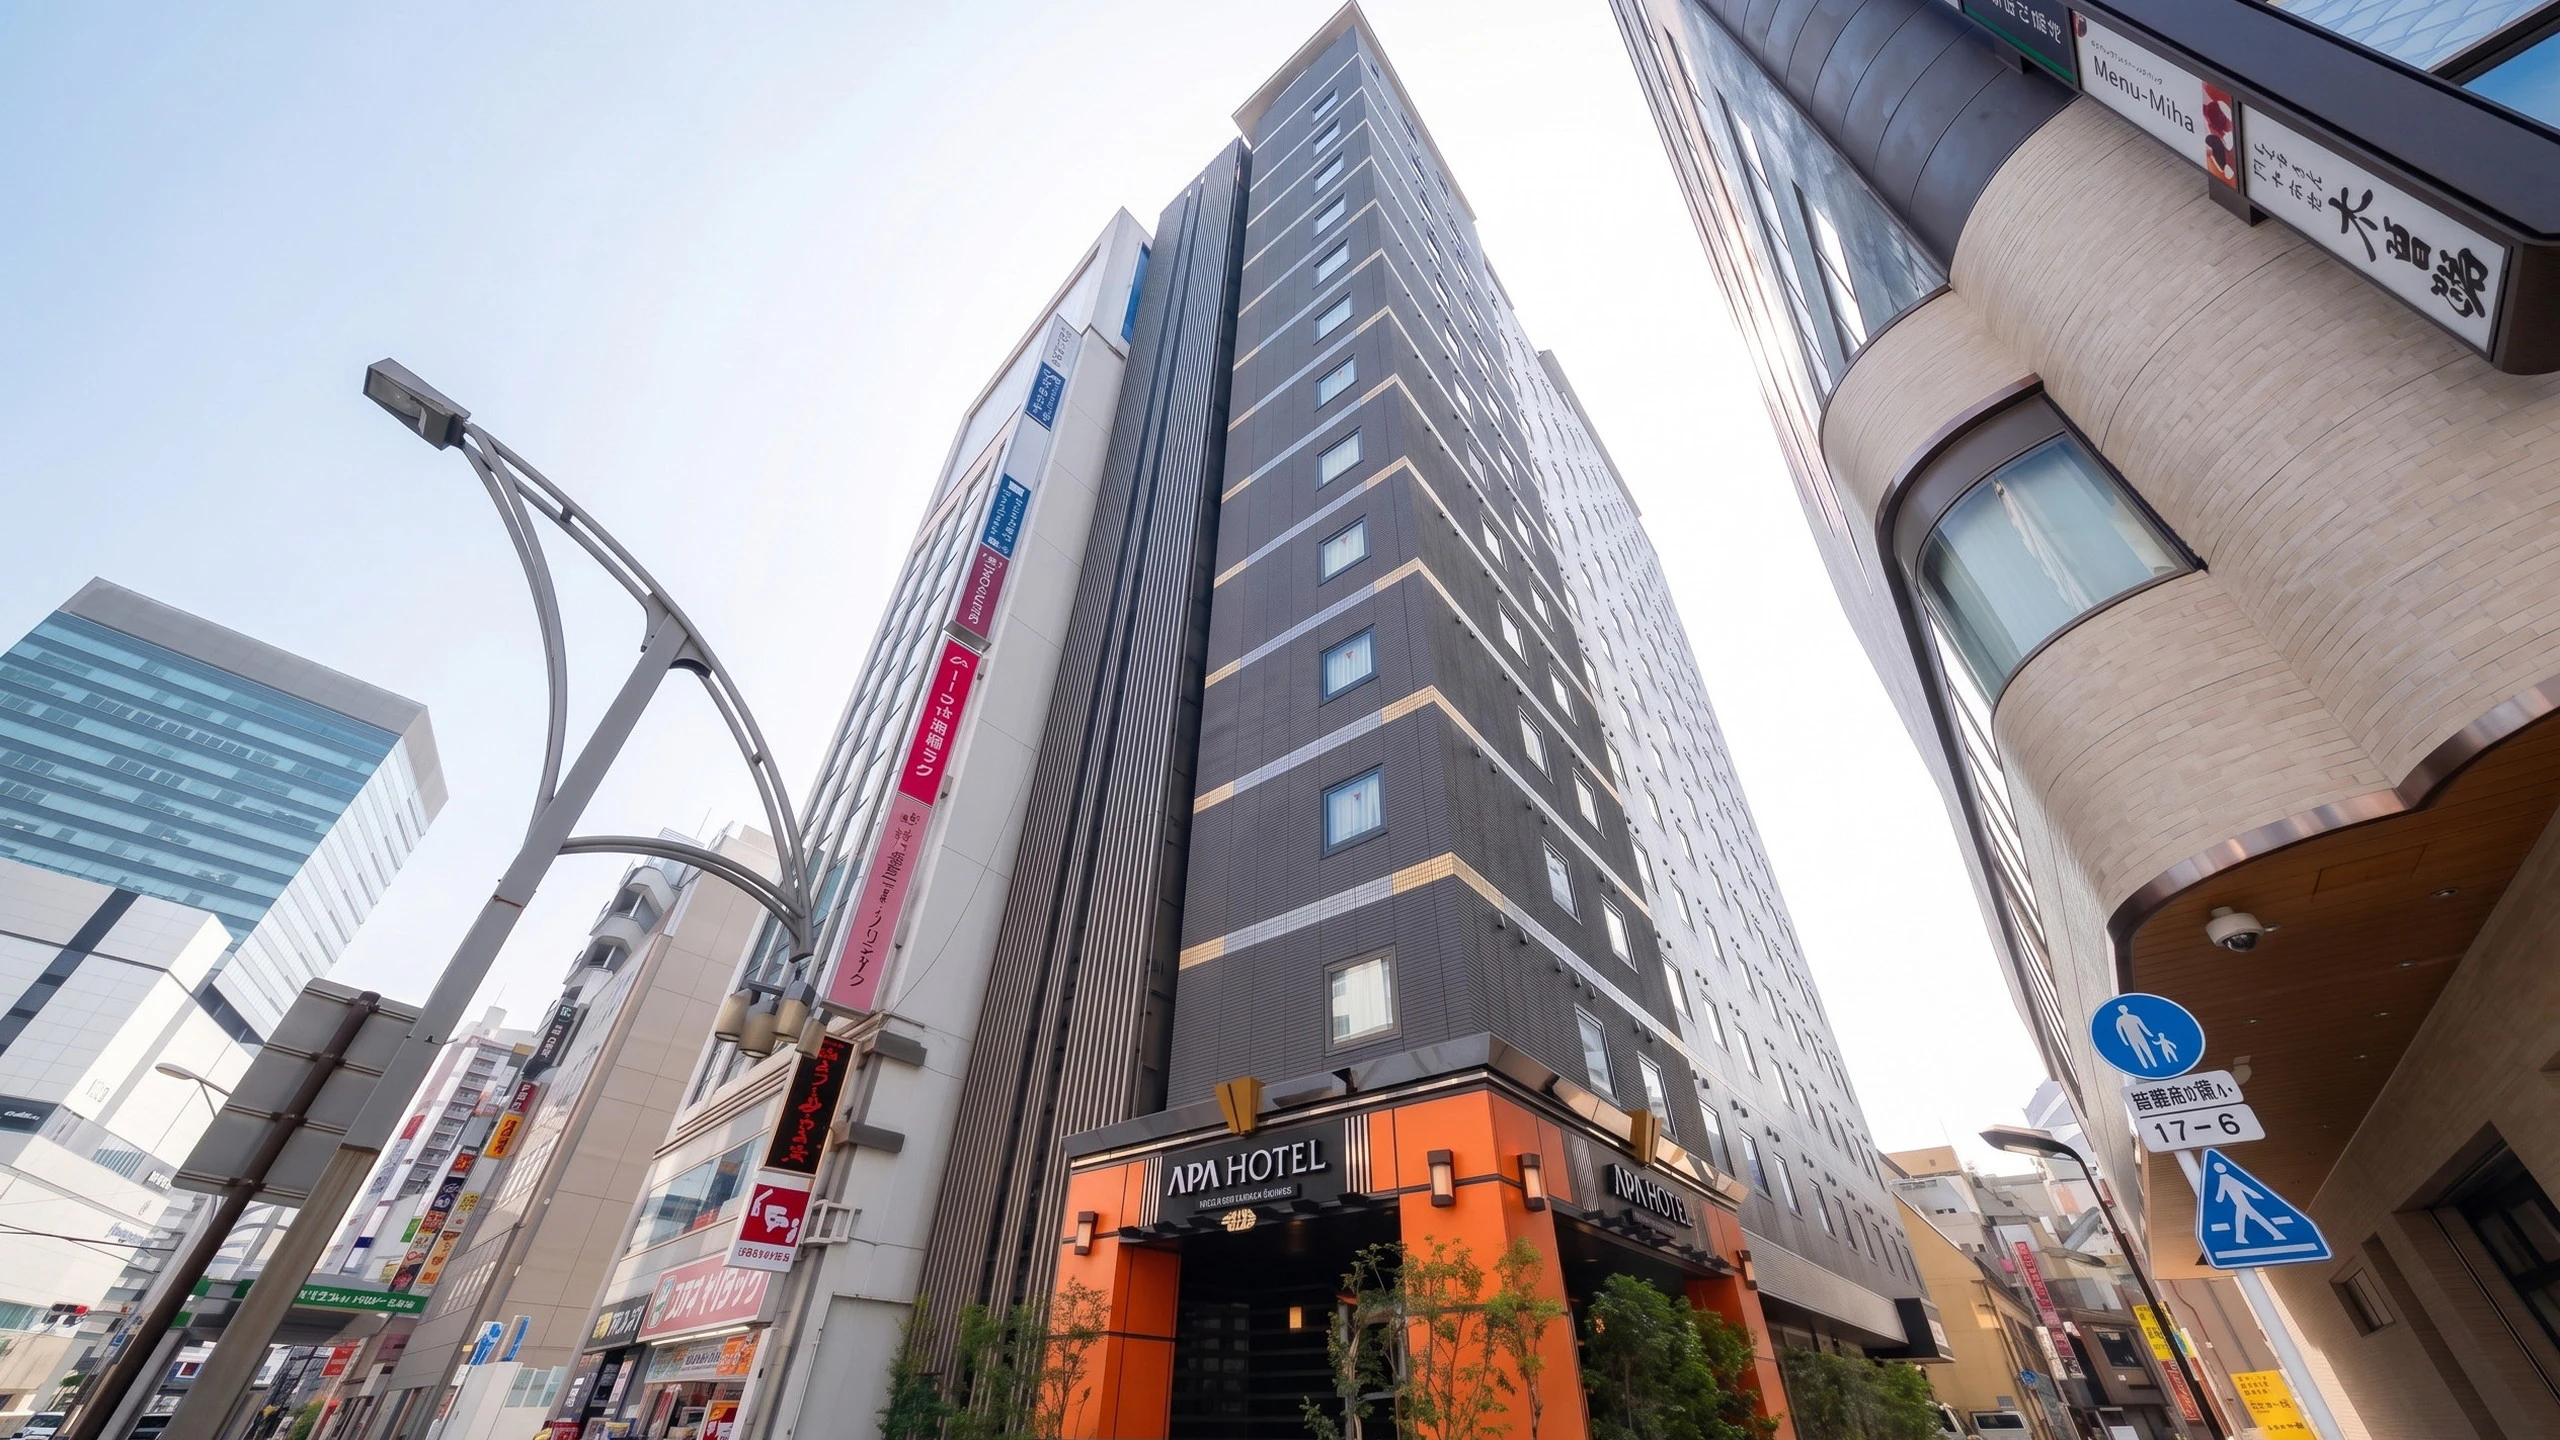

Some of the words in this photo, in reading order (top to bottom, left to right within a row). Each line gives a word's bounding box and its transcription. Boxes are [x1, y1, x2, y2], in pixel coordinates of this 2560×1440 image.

[2093, 55, 2195, 134] Menu-Miha
[1167, 1160, 1220, 1196] APA
[1226, 1139, 1327, 1186] HOTEL
[1614, 1164, 1648, 1208] APA
[1645, 1180, 1693, 1227] HOTEL
